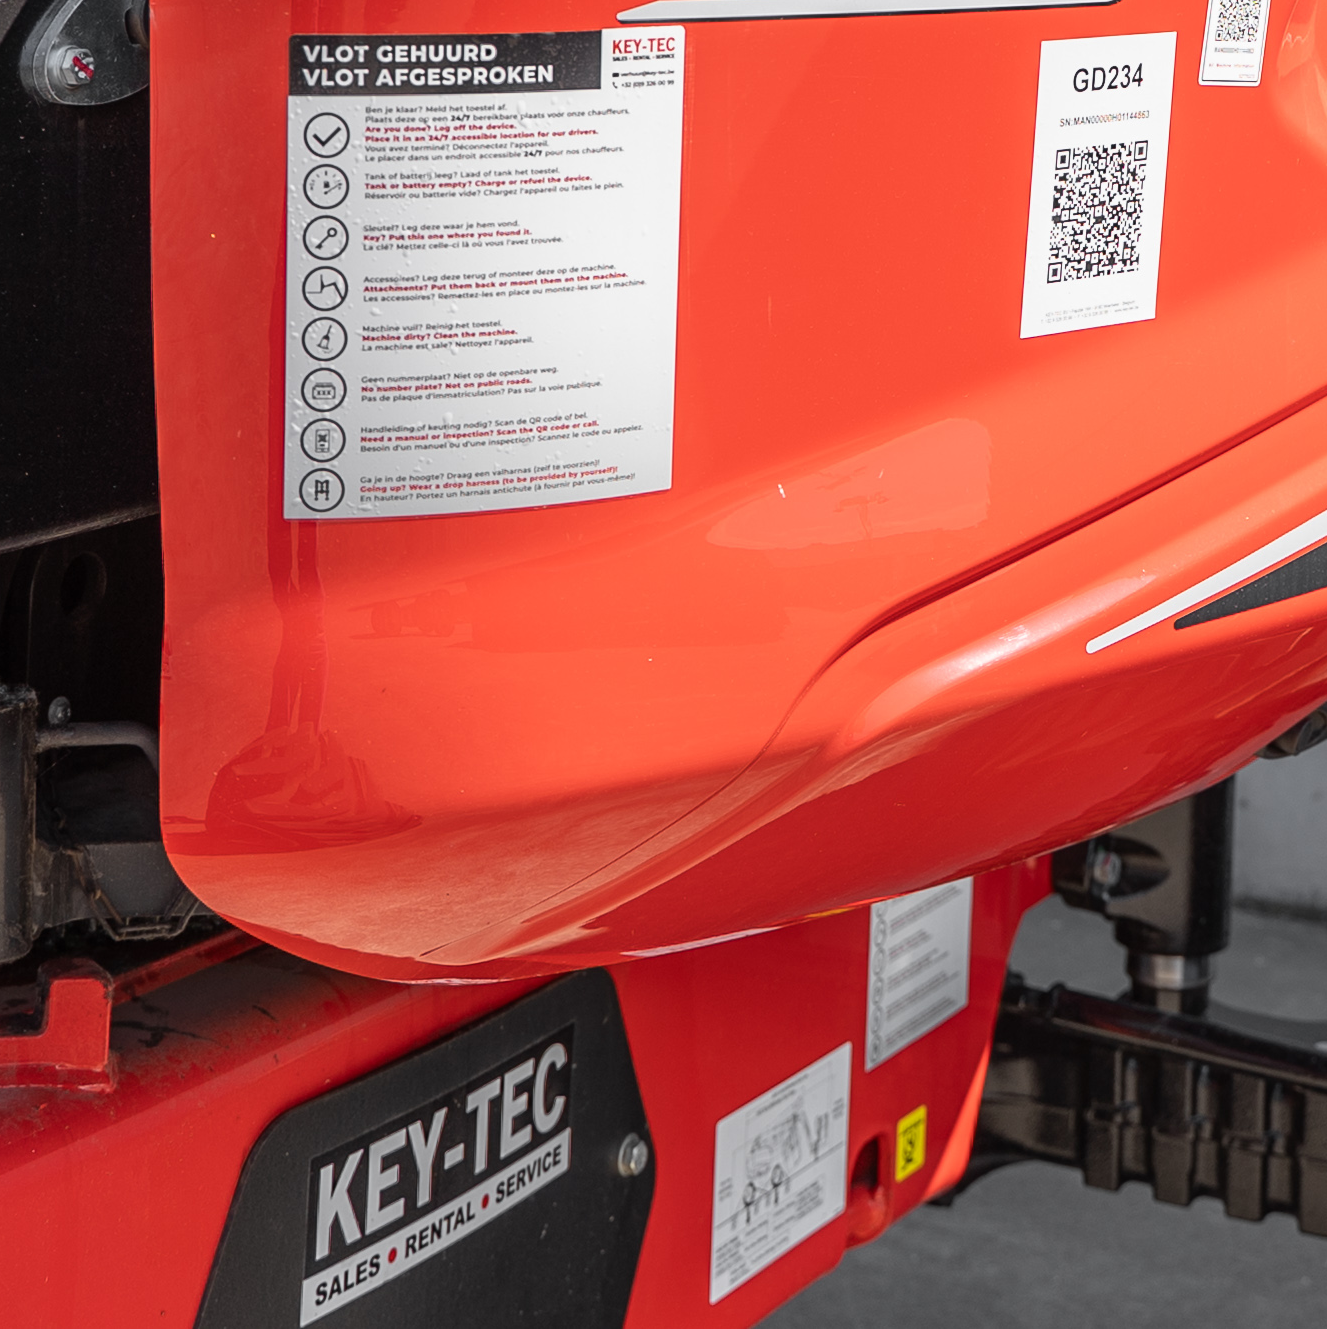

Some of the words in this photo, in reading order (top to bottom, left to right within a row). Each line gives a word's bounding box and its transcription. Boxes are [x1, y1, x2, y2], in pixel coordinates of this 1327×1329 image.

[302, 45, 369, 63] VLOT
[376, 44, 497, 63] GEHUURD
[613, 37, 675, 54] KEY-TEC
[302, 68, 369, 86] VLOT
[375, 65, 554, 86] AFGESPROKEN
[1073, 63, 1143, 92] GD234
[315, 1042, 567, 1261] KEY-TEC
[315, 1254, 381, 1306] SALES
[404, 1201, 476, 1258] RENTAL
[495, 1144, 562, 1204] SERVICE
